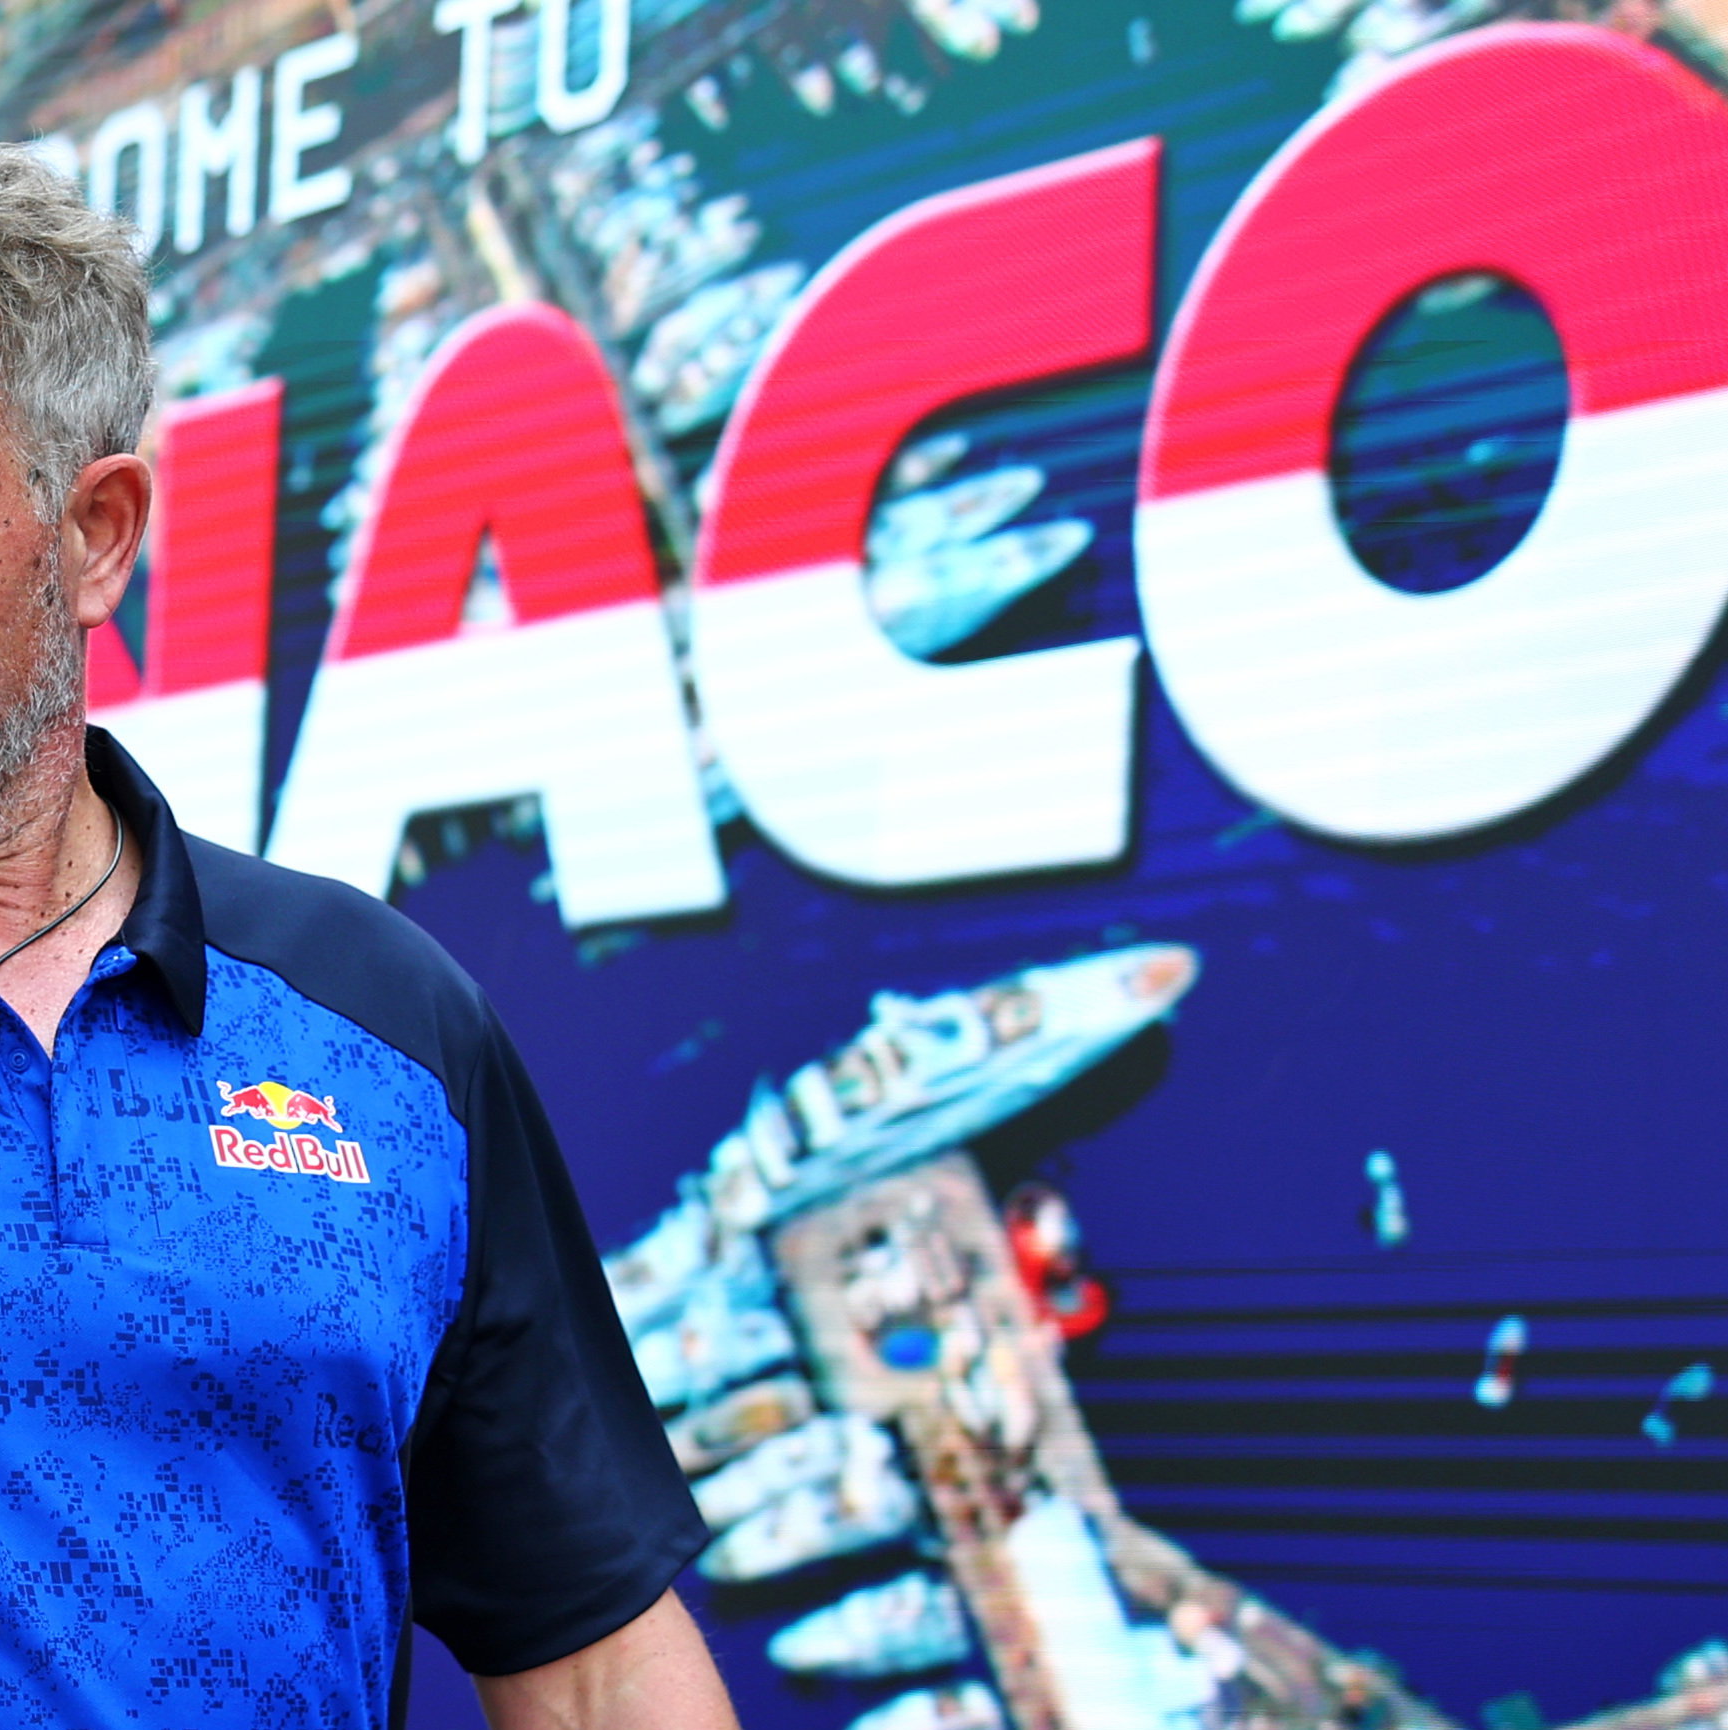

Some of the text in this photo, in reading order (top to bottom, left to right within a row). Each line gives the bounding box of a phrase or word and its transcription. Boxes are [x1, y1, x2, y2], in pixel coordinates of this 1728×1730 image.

[433, 0, 631, 165] TO
[208, 1125, 371, 1184] Red Bull
